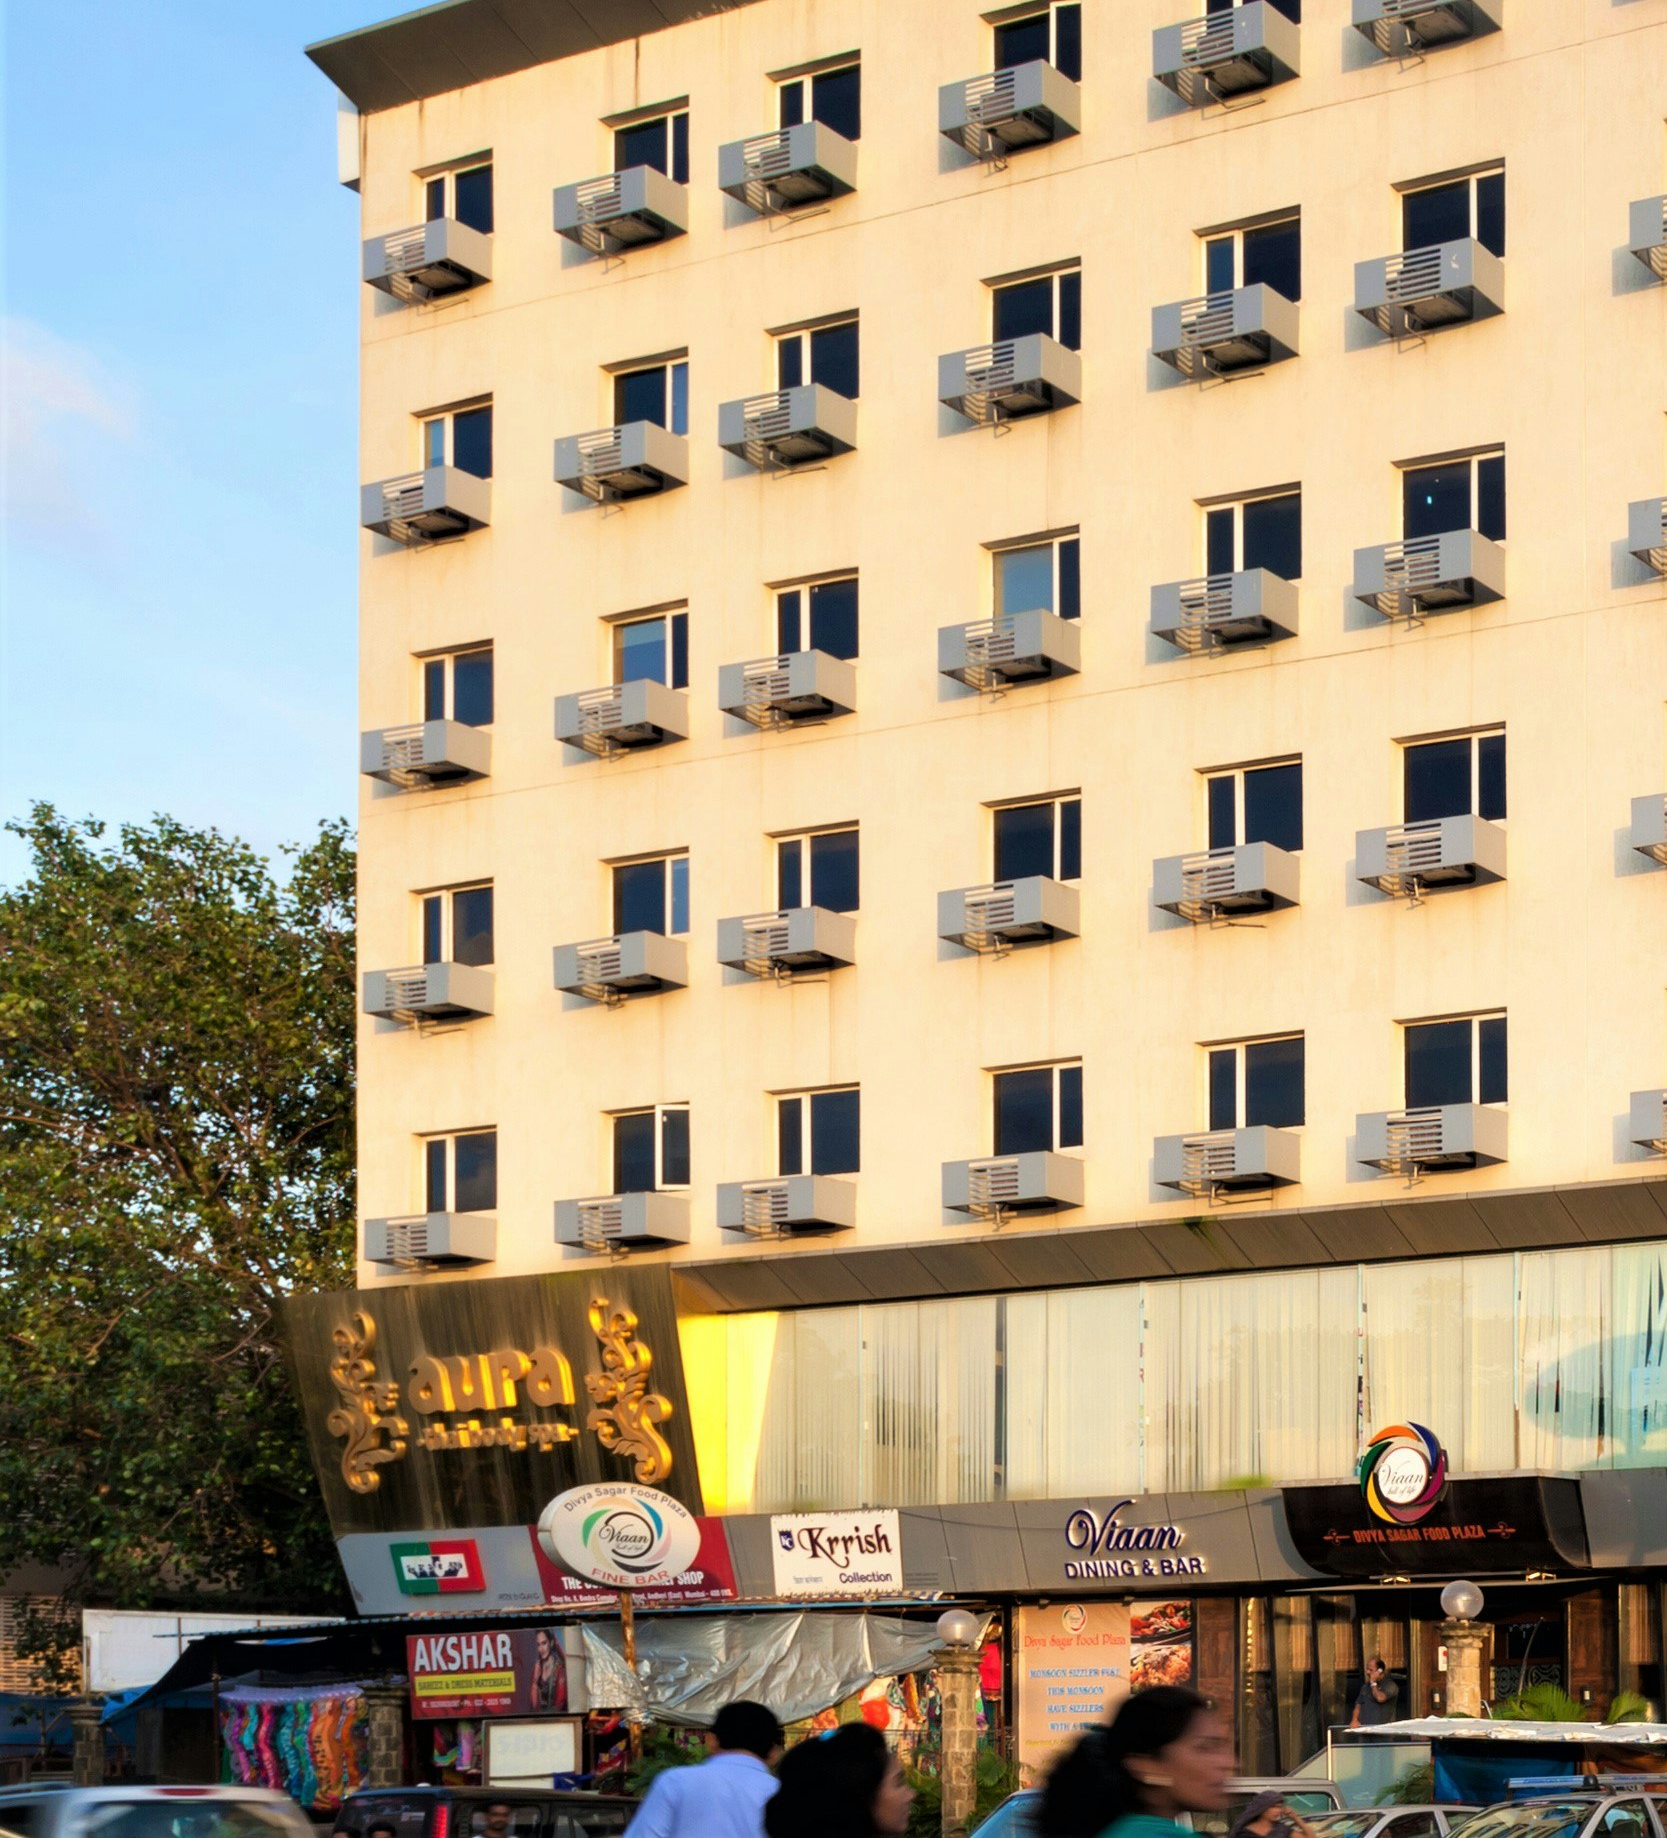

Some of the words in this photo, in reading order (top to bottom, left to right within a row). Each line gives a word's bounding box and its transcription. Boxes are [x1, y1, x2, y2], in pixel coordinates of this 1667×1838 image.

[408, 1347, 575, 1414] aura
[564, 1492, 592, 1512] Divya
[595, 1487, 626, 1497] Sagar
[631, 1487, 658, 1500] Food
[660, 1495, 687, 1519] Plaza
[599, 1524, 648, 1543] Viaan
[1065, 1499, 1186, 1556] Viaan
[1353, 1529, 1386, 1543] DIVYA
[1388, 1528, 1421, 1541] SAGAR
[1423, 1527, 1450, 1541] FOOD
[1453, 1525, 1485, 1539] PLAZA
[797, 1524, 892, 1568] Krrish
[592, 1568, 630, 1584] FINE
[635, 1571, 669, 1585] BAR
[678, 1571, 704, 1586] SHOP
[839, 1572, 892, 1584] Collection
[1065, 1560, 1139, 1579] DINING
[1143, 1558, 1158, 1576] &
[1161, 1557, 1207, 1576] BAR
[414, 1634, 513, 1672] AKSHAR
